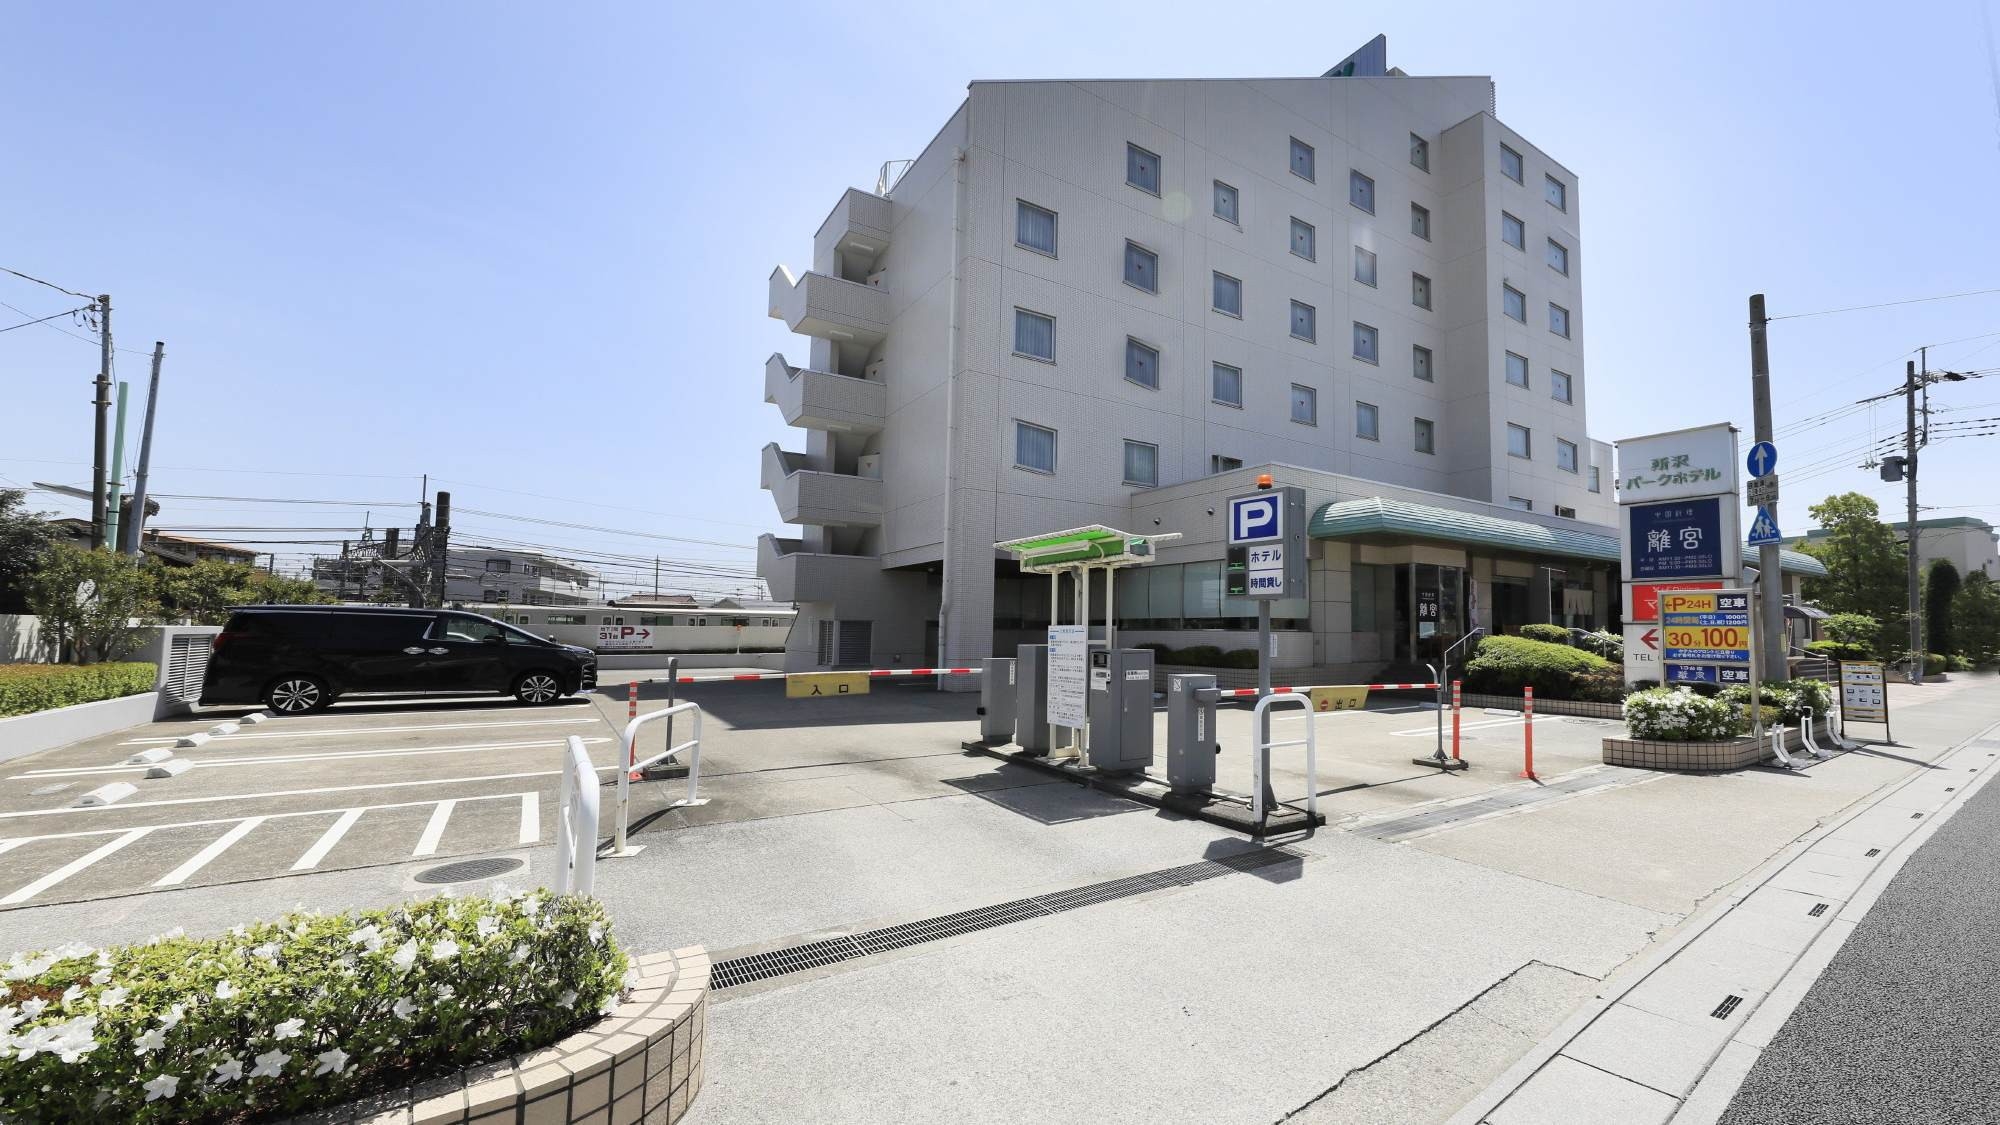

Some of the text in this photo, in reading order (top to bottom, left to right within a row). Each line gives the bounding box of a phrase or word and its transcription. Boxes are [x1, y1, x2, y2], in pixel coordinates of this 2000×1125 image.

[1626, 467, 1721, 490] パークホテル
[1239, 500, 1273, 538] P
[1647, 526, 1703, 552] 離宮
[1250, 549, 1282, 564] ホテル
[1250, 576, 1282, 589] 時間貸し
[1719, 598, 1746, 608] 空車
[620, 626, 635, 640] P
[1632, 653, 1655, 662] TEL
[1721, 670, 1748, 681] 空車
[811, 684, 849, 696] 入口
[1335, 698, 1357, 710] 出口
